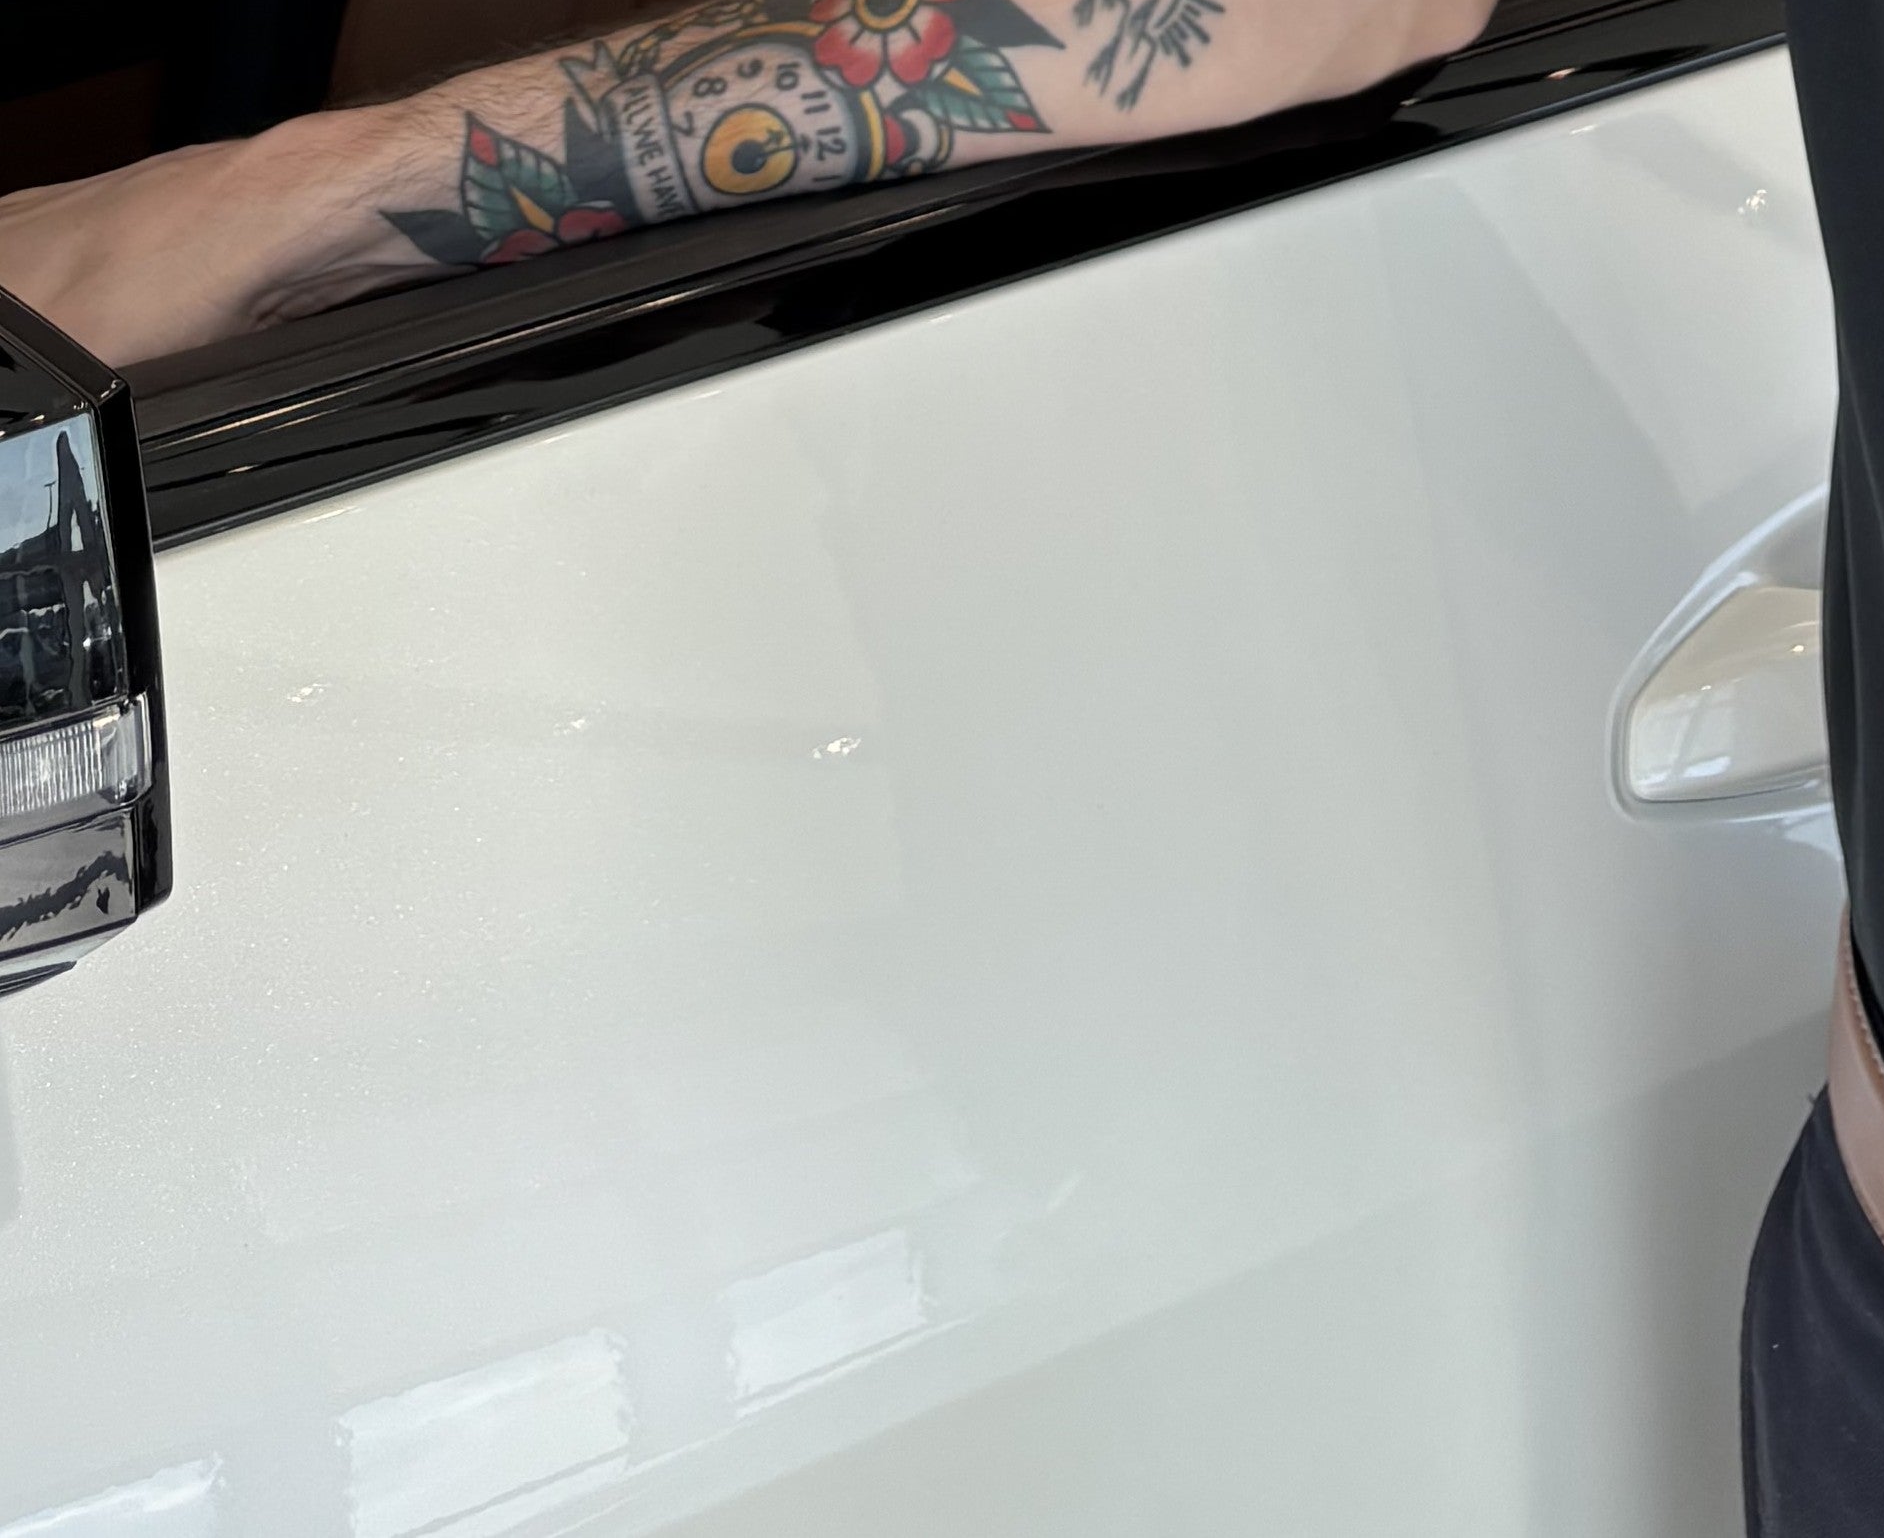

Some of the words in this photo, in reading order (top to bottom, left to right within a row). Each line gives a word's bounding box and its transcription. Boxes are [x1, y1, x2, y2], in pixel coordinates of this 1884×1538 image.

[693, 76, 727, 98] 8
[776, 62, 800, 91] 10
[801, 90, 831, 114] 11
[673, 110, 695, 137] 7
[816, 127, 847, 161] 12
